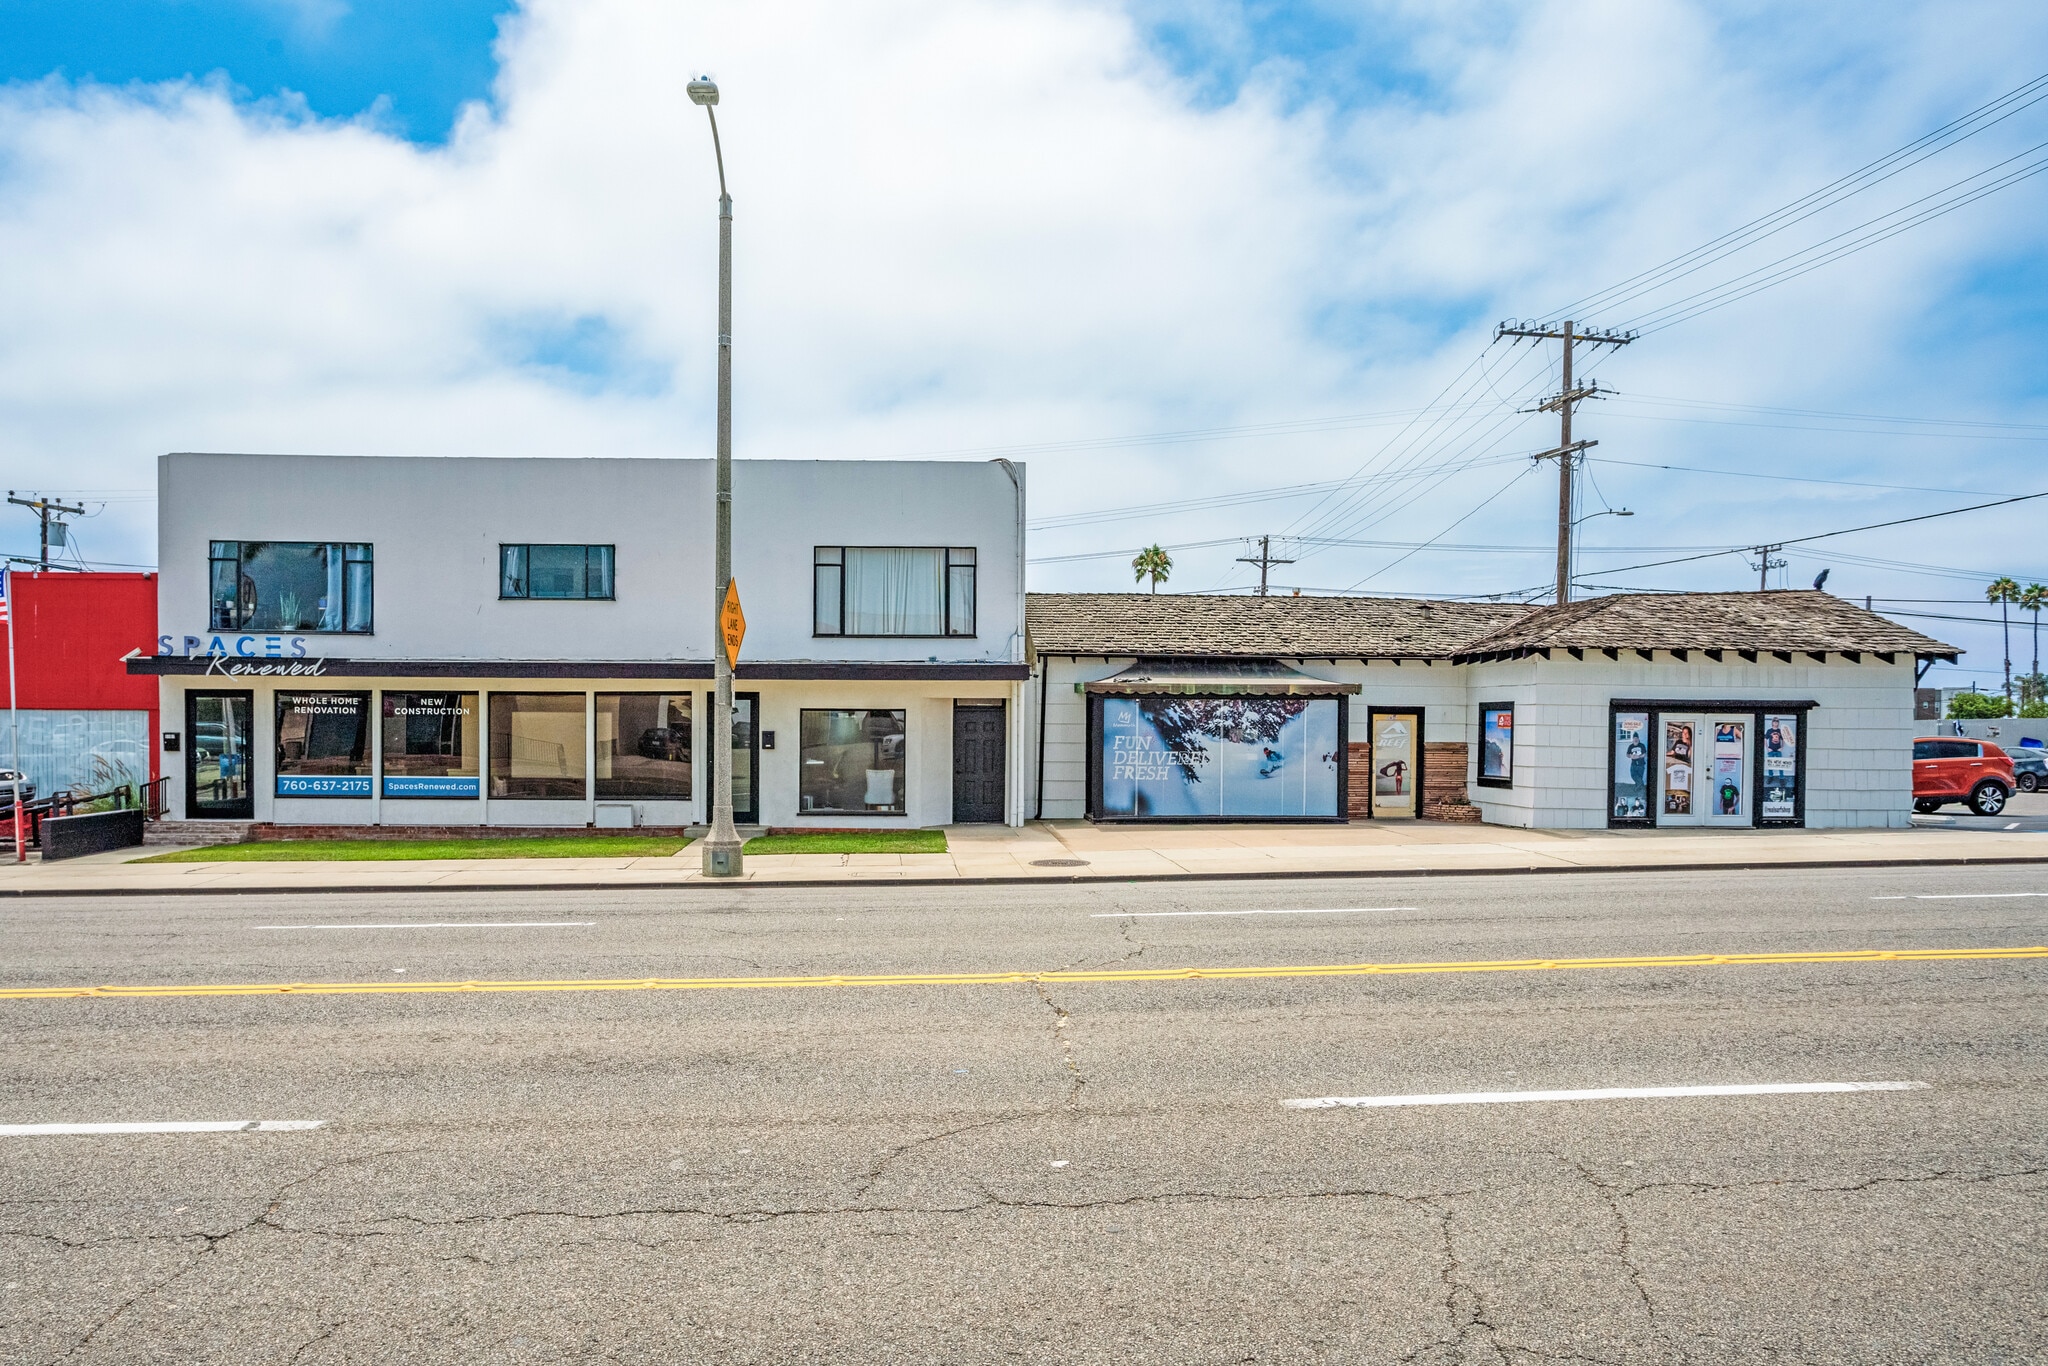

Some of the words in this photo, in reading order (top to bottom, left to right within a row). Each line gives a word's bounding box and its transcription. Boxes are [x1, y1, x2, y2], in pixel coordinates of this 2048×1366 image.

[726, 600, 739, 615] RIGHT
[727, 617, 738, 631] LANE
[158, 634, 306, 658] SPACES
[727, 633, 739, 647] ENDS
[189, 654, 327, 682] Renewed
[292, 697, 328, 705] WHOLE
[331, 697, 359, 705] HOME
[420, 698, 443, 706] NEW
[294, 706, 356, 714] RENOVATION
[394, 707, 470, 715] CONSTRUCTION
[1112, 735, 1153, 750] FUN
[1378, 738, 1408, 749] REEF
[1112, 765, 1170, 780] FRESH
[282, 780, 370, 791] 760-637-2175
[388, 782, 477, 791] SpacesRenewed.com
